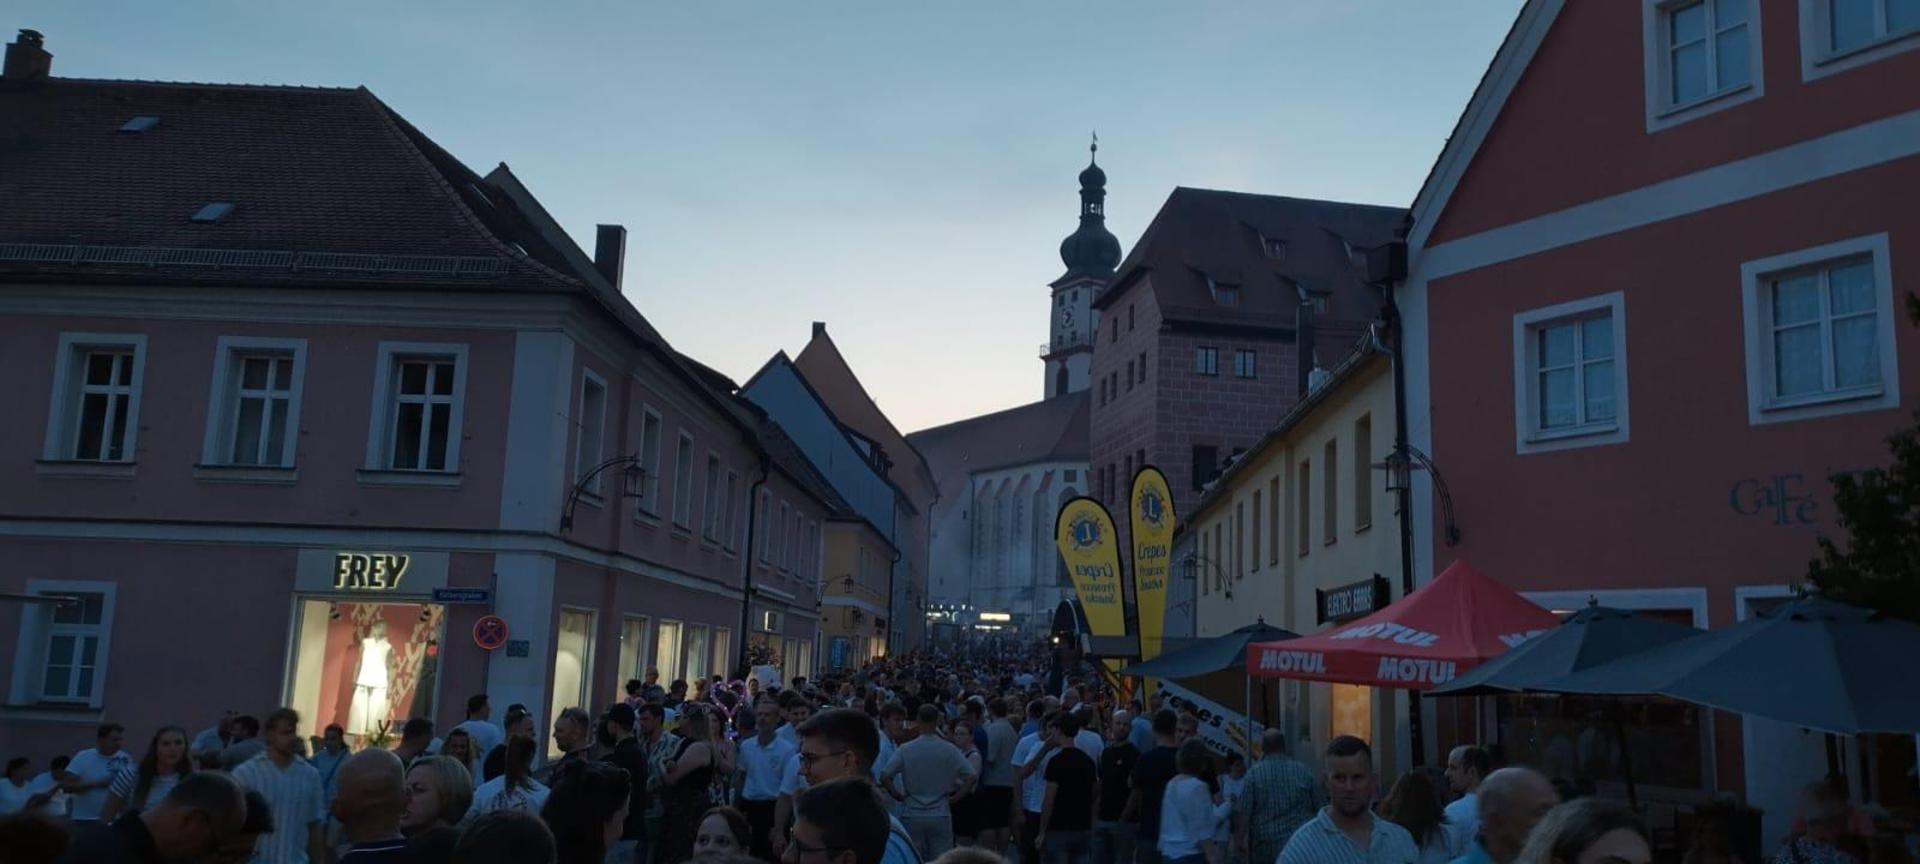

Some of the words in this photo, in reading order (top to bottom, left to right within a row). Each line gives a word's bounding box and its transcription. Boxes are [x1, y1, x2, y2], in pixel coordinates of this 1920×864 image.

[334, 553, 409, 588] FREY
[1328, 589, 1352, 617] ELEKTRO
[1330, 622, 1440, 647] MOTUL
[1261, 650, 1327, 673] MOTUL
[1376, 657, 1456, 684] MOTUL
